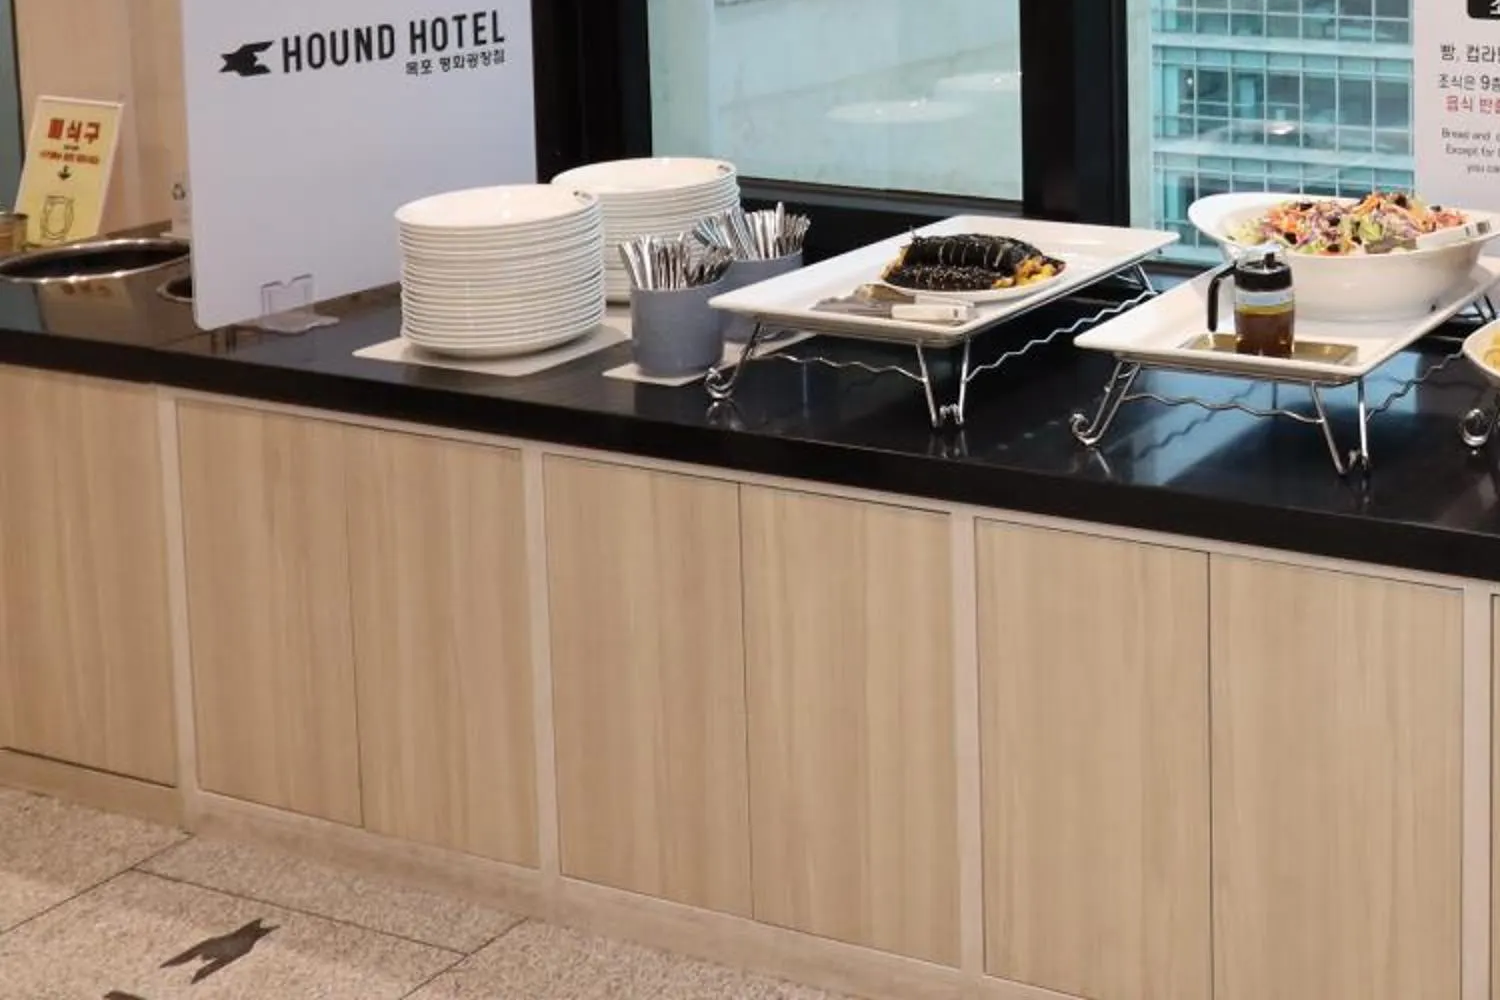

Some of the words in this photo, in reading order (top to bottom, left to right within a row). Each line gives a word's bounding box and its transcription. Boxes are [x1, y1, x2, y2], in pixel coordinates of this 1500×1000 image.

[282, 23, 395, 74] HOUND
[409, 9, 505, 55] HOTEL
[405, 59, 433, 77] 목포
[440, 48, 505, 73] 평화광장점
[1438, 73, 1476, 91] 조식은
[1445, 95, 1473, 113] 음식
[1441, 127, 1470, 140] Bread
[1472, 131, 1491, 142] and
[1445, 143, 1478, 158] Except
[1481, 145, 1495, 157] for
[1467, 164, 1485, 176] you
